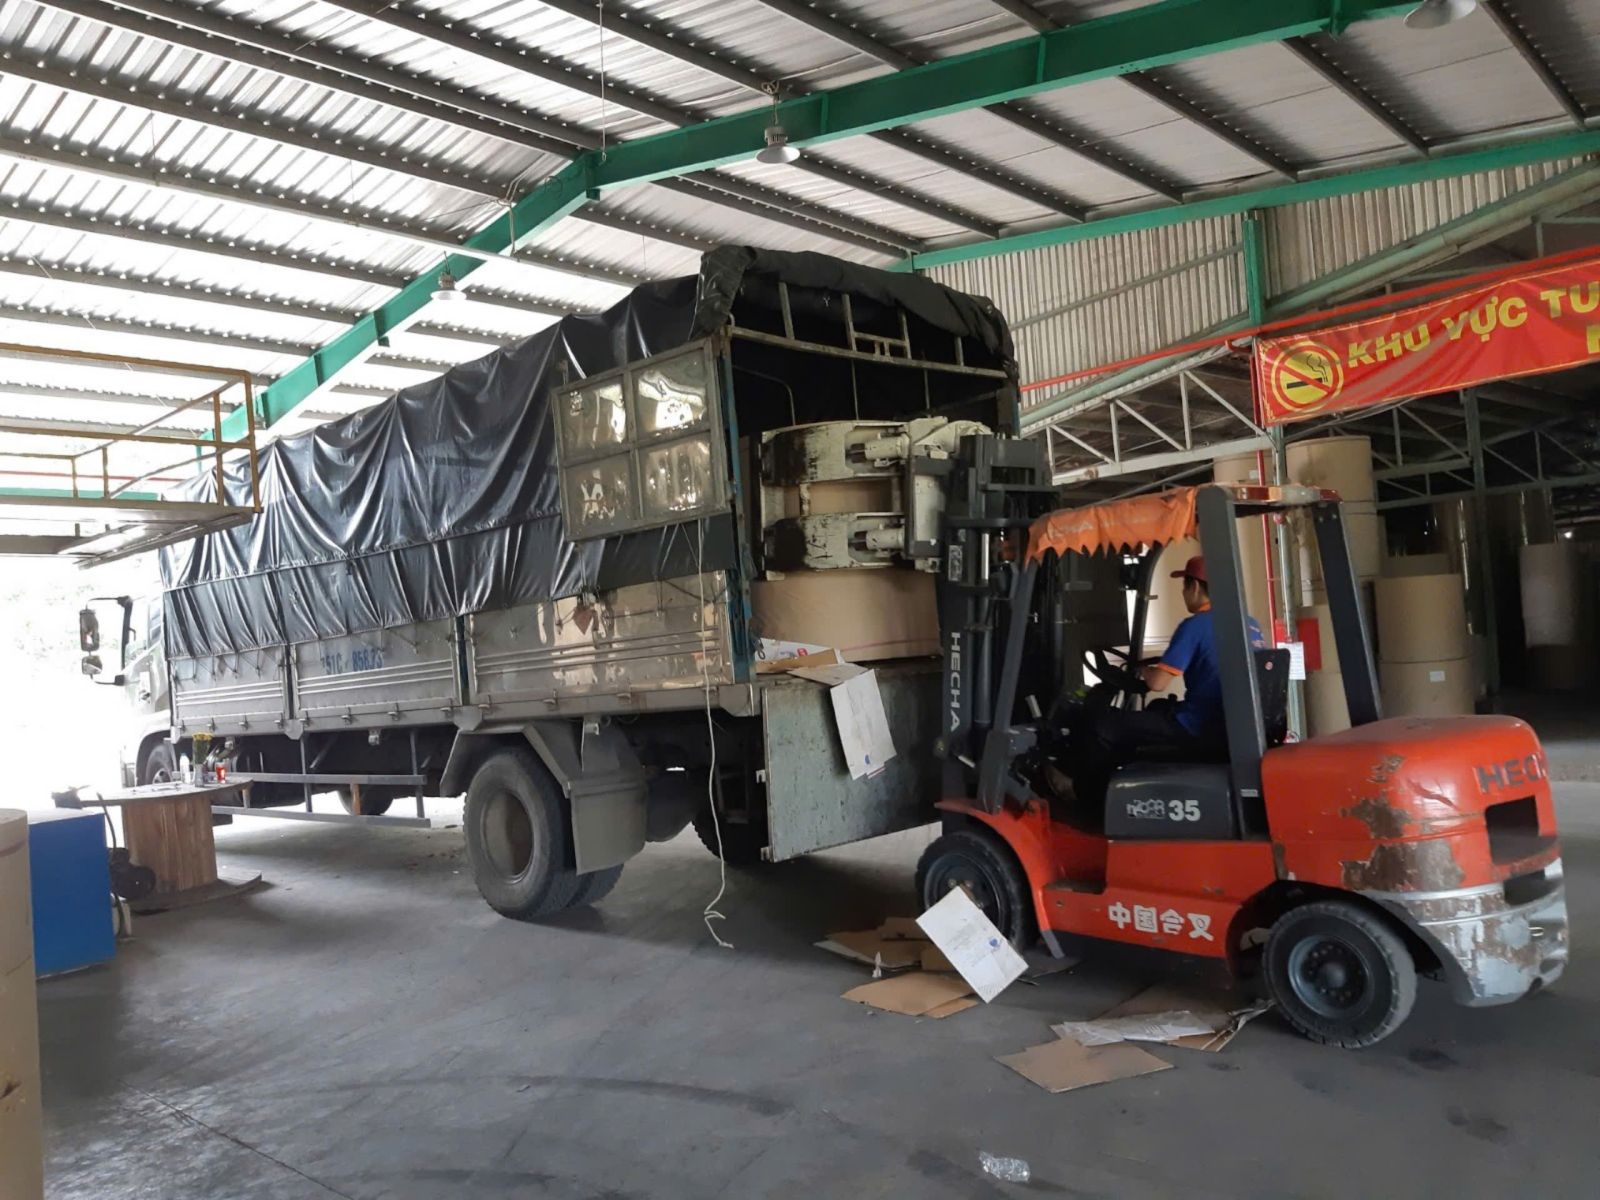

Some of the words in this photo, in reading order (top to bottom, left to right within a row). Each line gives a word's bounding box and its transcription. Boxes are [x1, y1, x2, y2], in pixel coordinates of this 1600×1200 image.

[1348, 324, 1430, 368] KHU
[1441, 296, 1528, 343] VỰC
[950, 631, 961, 733] HECHA
[1168, 799, 1201, 822] 35
